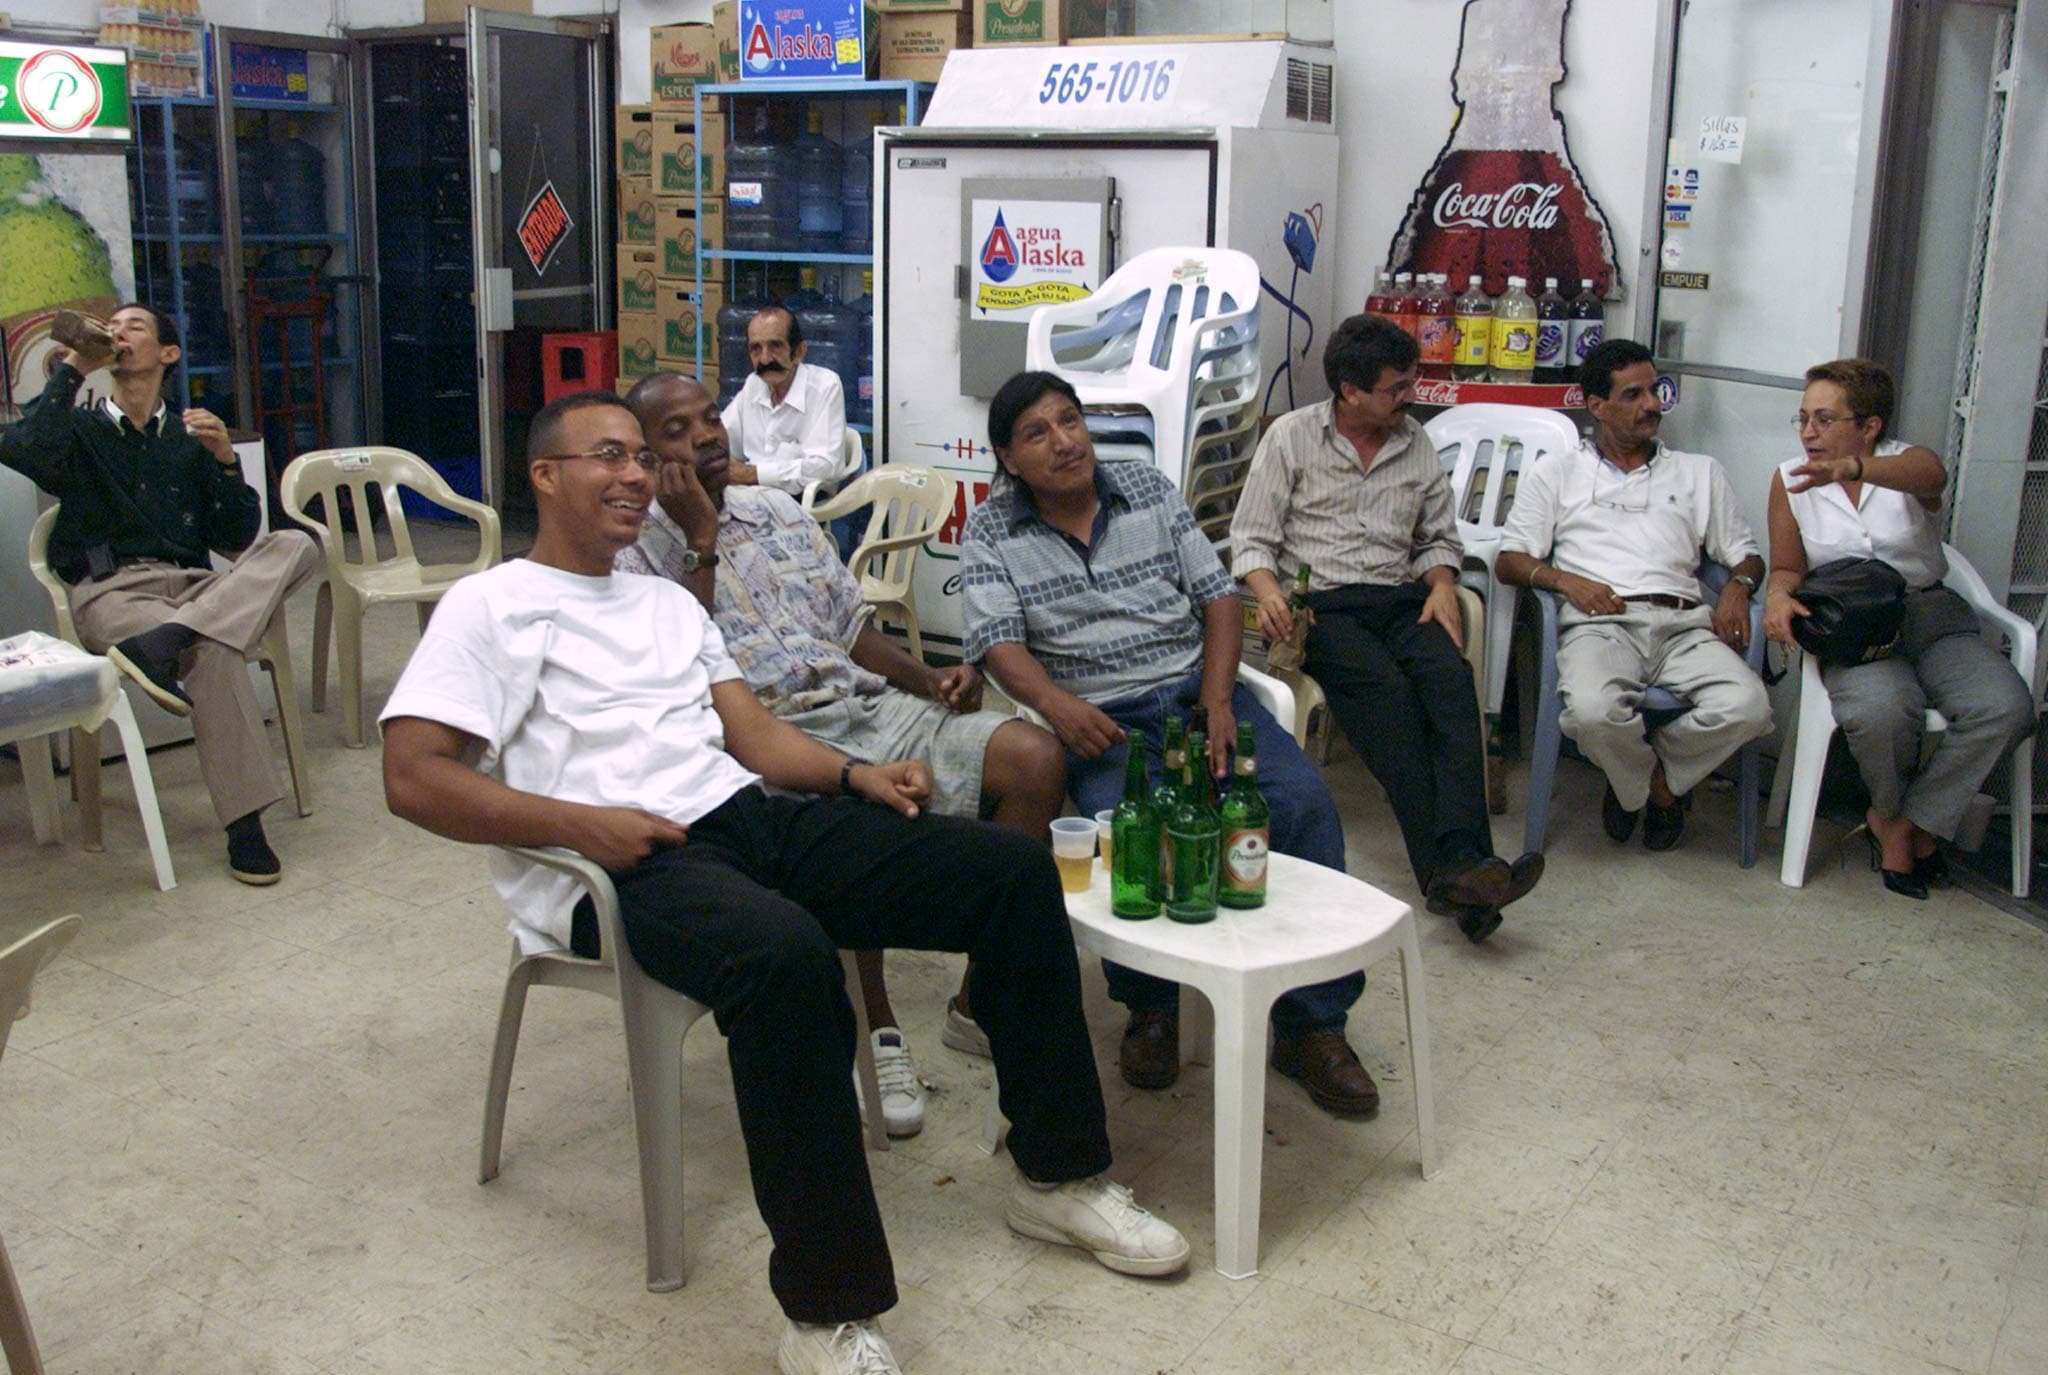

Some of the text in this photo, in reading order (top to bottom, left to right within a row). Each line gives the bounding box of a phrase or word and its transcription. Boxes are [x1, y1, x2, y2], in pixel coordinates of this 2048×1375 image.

[745, 23, 833, 60] Alaska
[1039, 59, 1176, 104] 565-1016
[1432, 182, 1565, 229] Coca-Cola
[521, 190, 567, 265] ENTRADA
[983, 226, 1085, 266] Alaska
[1016, 227, 1062, 245] agua
[990, 284, 1070, 297] GOTA A GOTA
[1028, 294, 1040, 302] EN
[1663, 273, 1705, 287] EMPUJE
